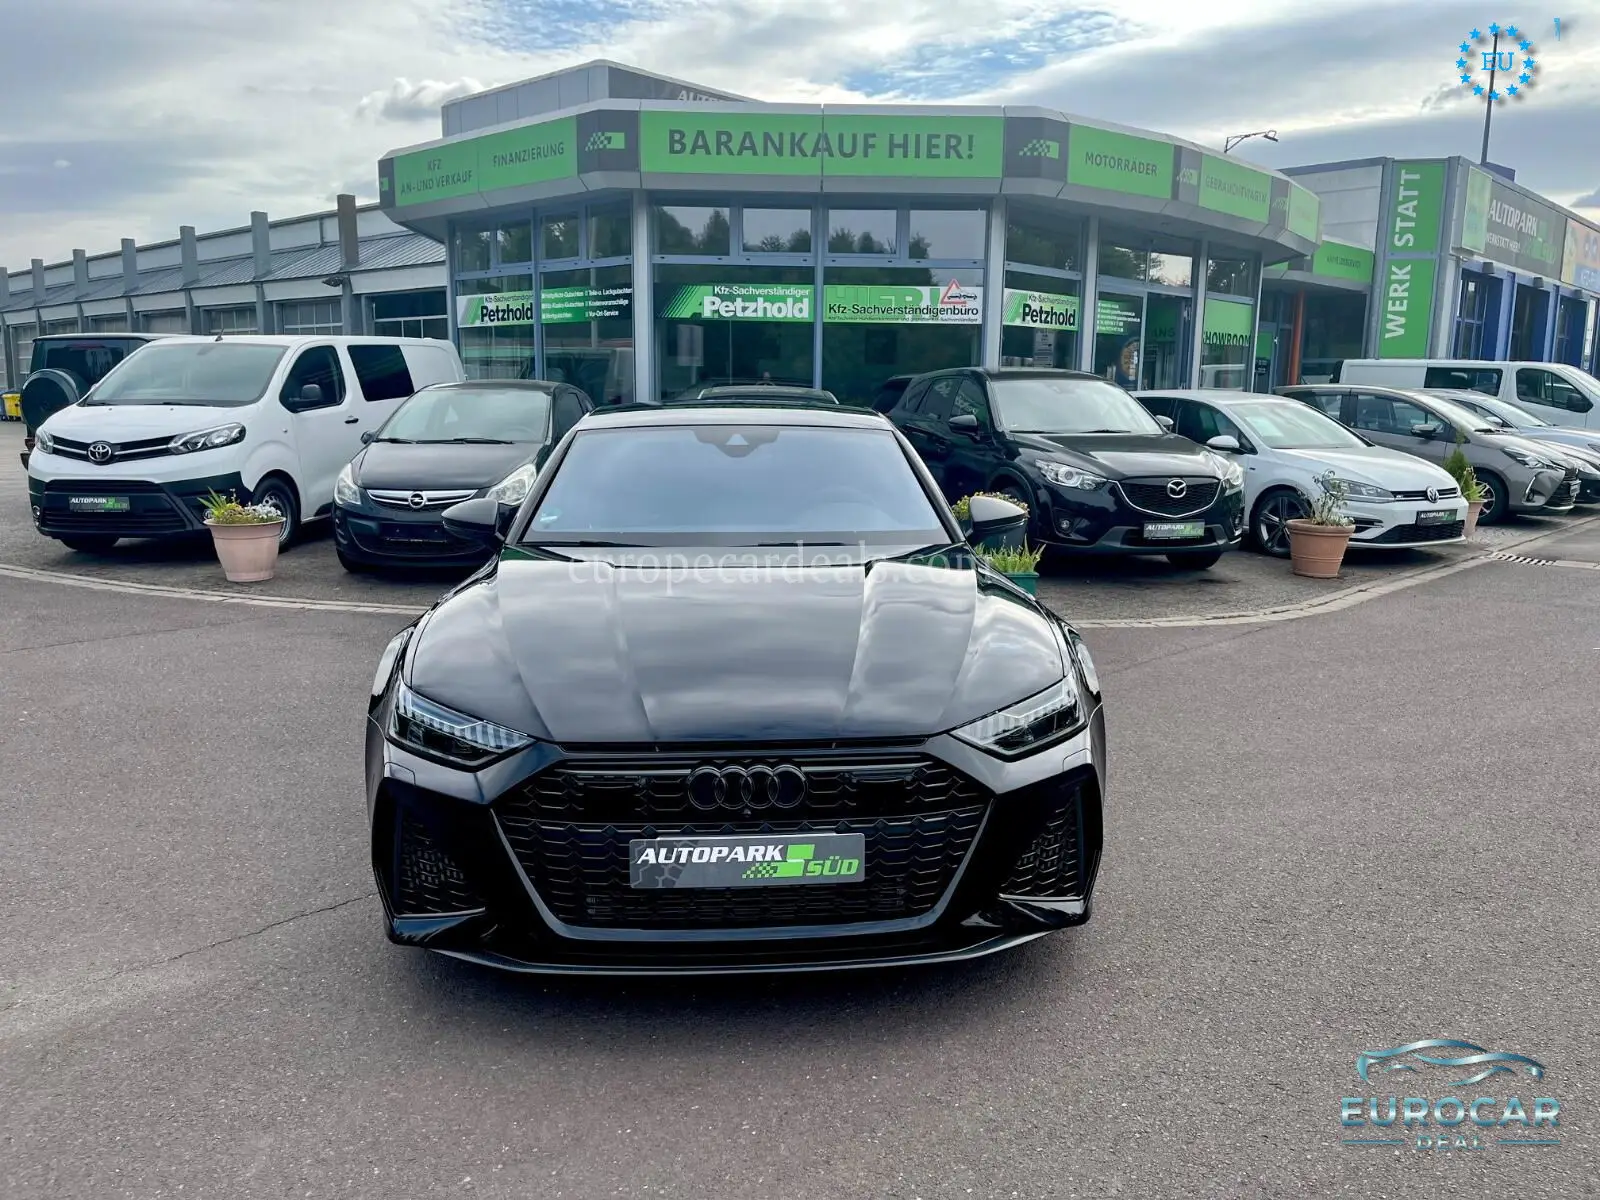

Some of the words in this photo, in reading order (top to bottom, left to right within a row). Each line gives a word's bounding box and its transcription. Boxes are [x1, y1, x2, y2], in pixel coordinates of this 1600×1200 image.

[493, 142, 564, 168] FINANZIERUNG
[668, 129, 877, 158] BARANKAUF
[888, 133, 976, 160] HIER!
[427, 158, 442, 171] KFZ
[1085, 151, 1158, 177] MOTORRÄDER
[416, 178, 433, 192] UND
[435, 170, 473, 188] VERKAUF
[1395, 169, 1420, 247] STATT
[1488, 199, 1538, 237] AUTOPARK
[714, 285, 810, 298] Kfz-Sachverständiger
[1384, 264, 1411, 339] WERK
[480, 302, 533, 323] Petzhold
[703, 295, 809, 319] Petzhold
[828, 303, 979, 318] Kfz-Sachverständigenbüro
[1022, 302, 1076, 327] Petzhold
[636, 845, 784, 864] AUTOPARK
[804, 856, 859, 876] SÜD
